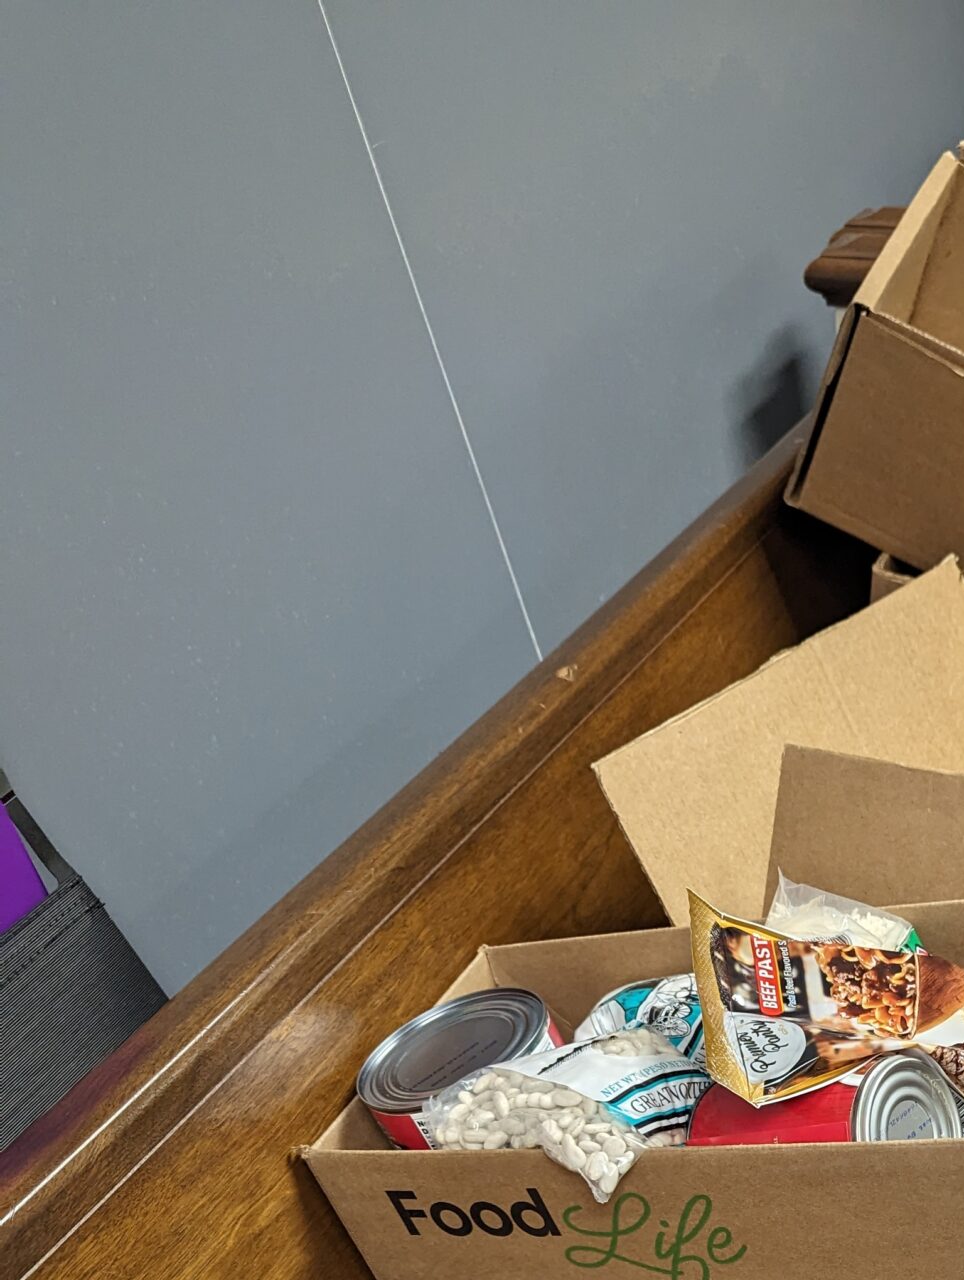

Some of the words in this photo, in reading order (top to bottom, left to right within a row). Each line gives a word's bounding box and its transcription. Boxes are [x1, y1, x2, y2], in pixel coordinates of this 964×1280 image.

[753, 935, 773, 979] PAST
[779, 946, 792, 976] Flavored
[760, 978, 778, 1010] BEEF
[784, 976, 793, 990] Beef
[599, 1080, 624, 1098] NET
[628, 1086, 672, 1116] GREAT
[385, 1187, 563, 1238] Food
